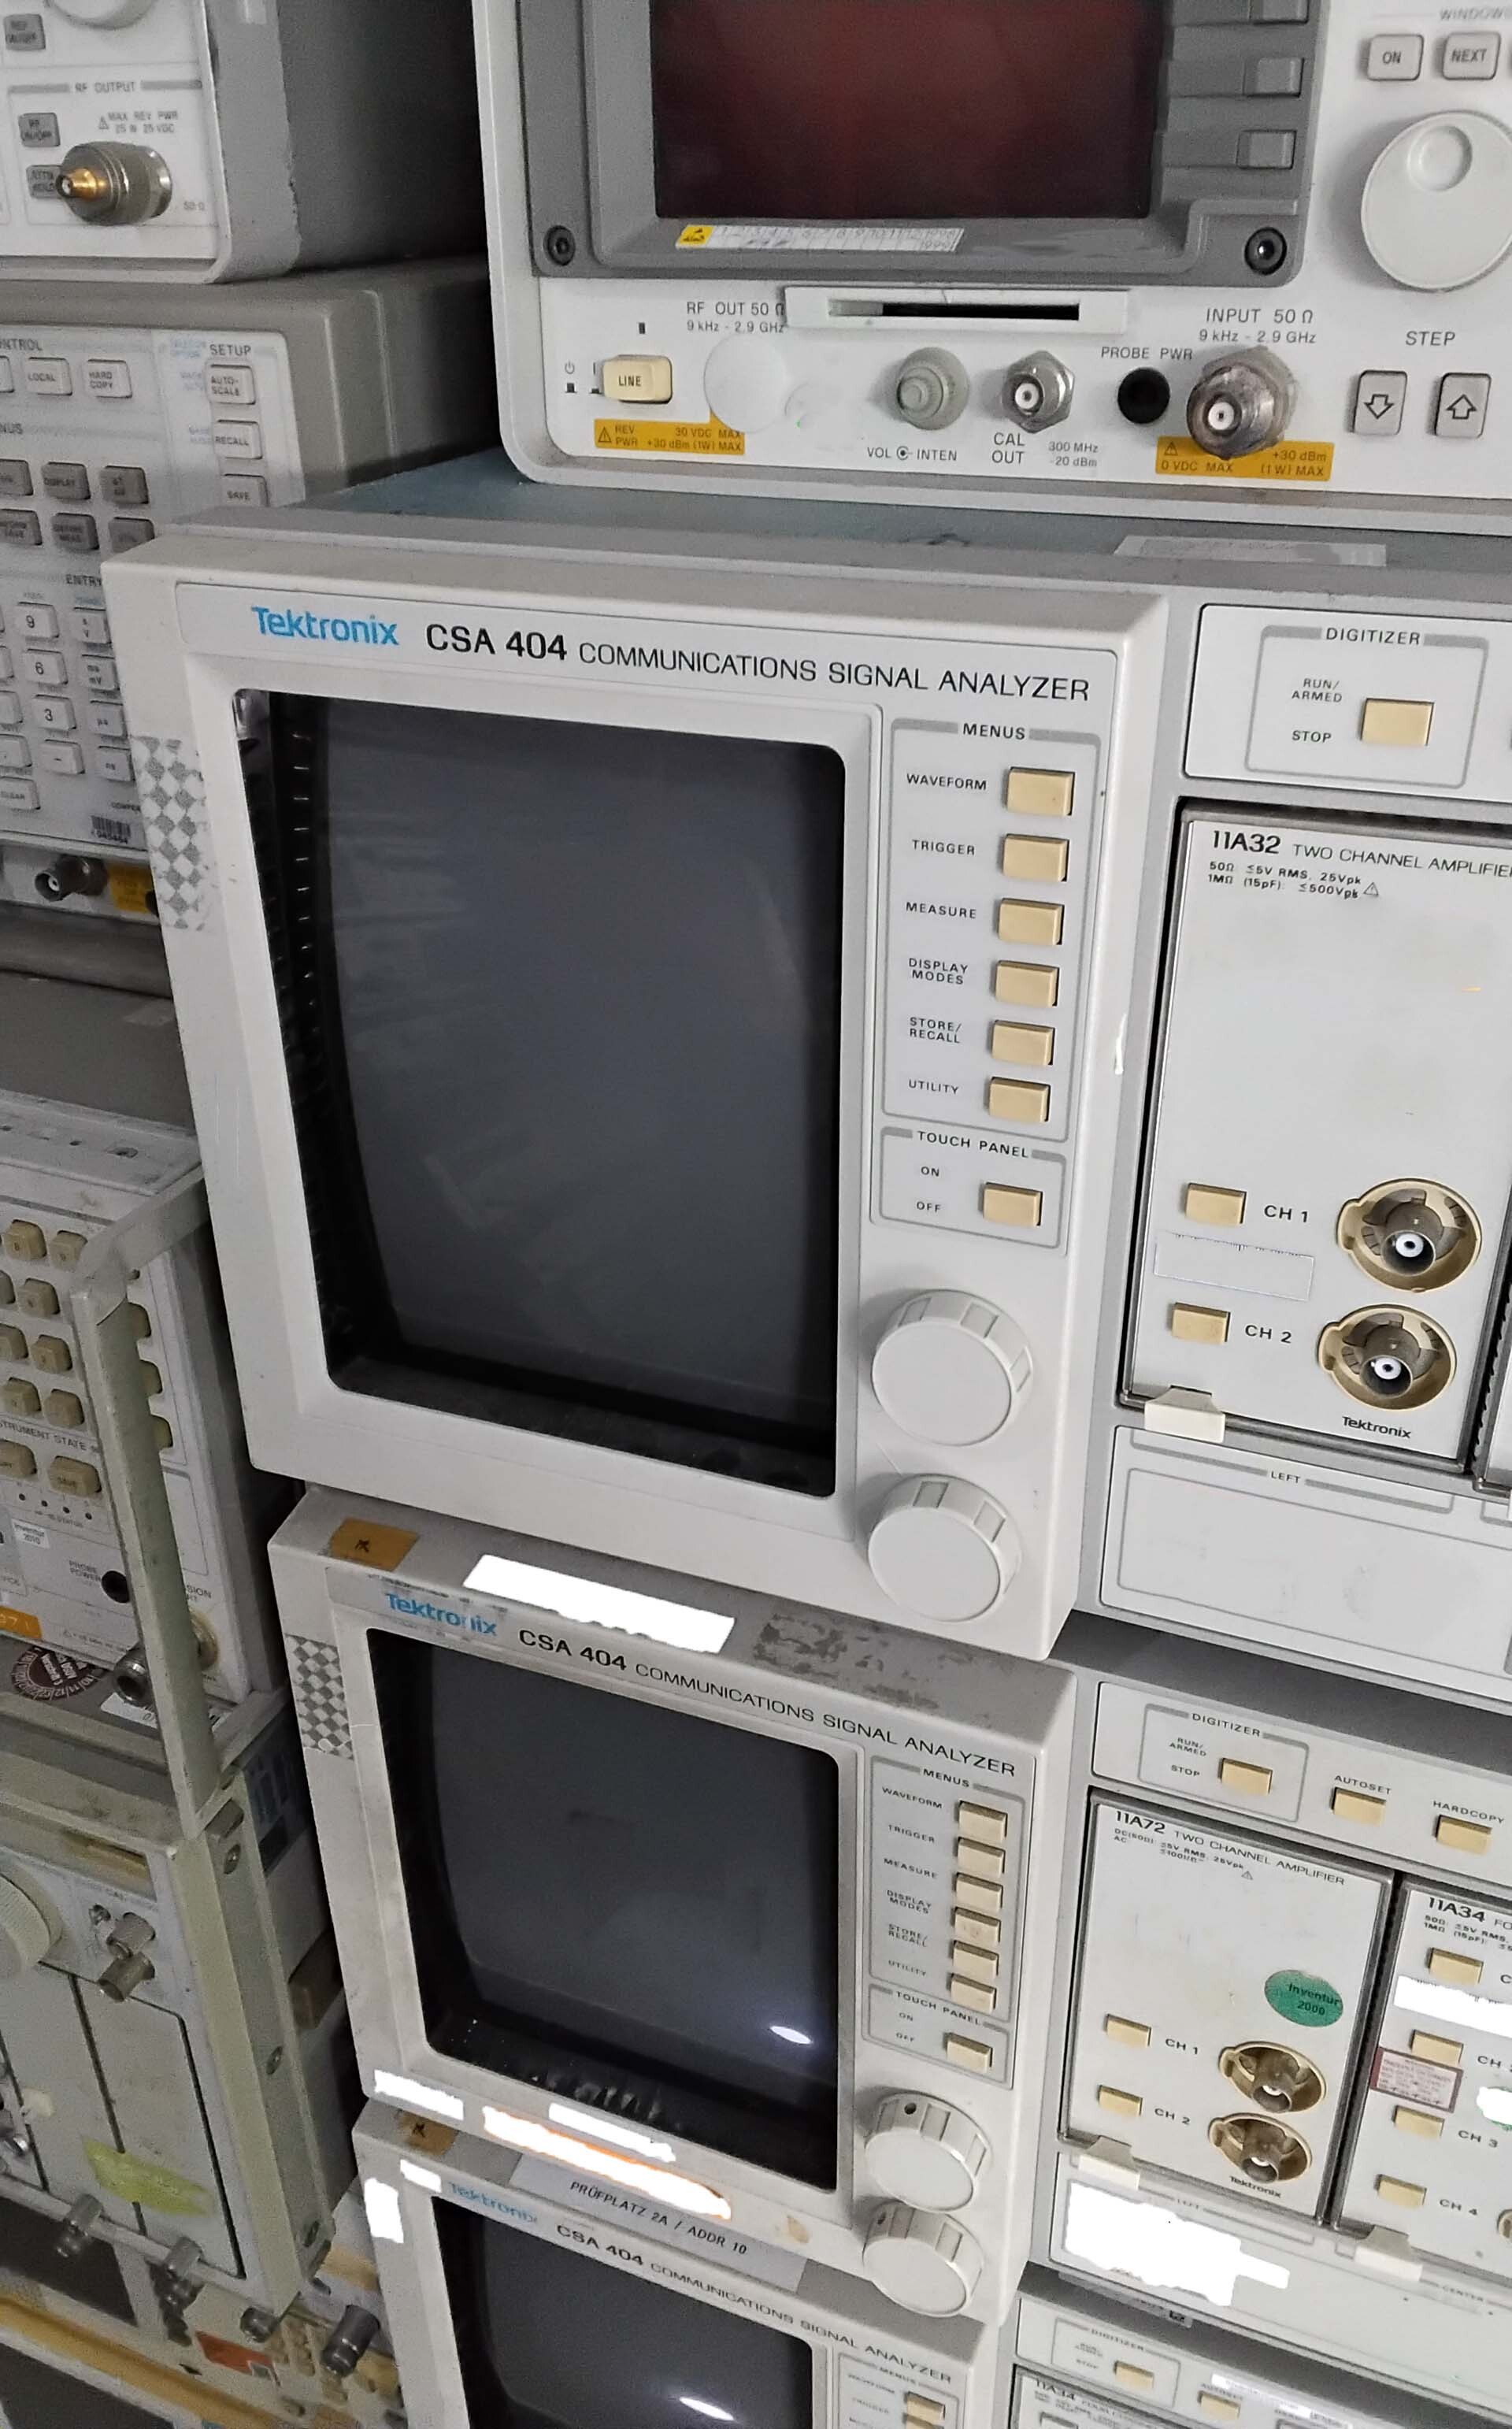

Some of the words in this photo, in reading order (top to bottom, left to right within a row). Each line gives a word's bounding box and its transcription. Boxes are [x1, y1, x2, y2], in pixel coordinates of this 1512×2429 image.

[1440, 6, 1505, 20] WINDOW
[1381, 52, 1402, 65] ON
[1451, 49, 1488, 62] NEXT
[75, 81, 87, 92] RF
[94, 82, 136, 93] OUTPUT
[687, 302, 705, 314] RF
[715, 302, 745, 315] OUT
[751, 302, 769, 315] 50
[1206, 308, 1262, 324] INPUT
[1273, 309, 1297, 324] 50
[687, 321, 694, 332] 9
[698, 321, 720, 332] kHz
[759, 321, 784, 333] GHz
[1199, 331, 1208, 342] 9
[1212, 331, 1239, 342] kHz
[1285, 332, 1317, 343] GHz
[1405, 332, 1456, 347] STEP
[209, 344, 251, 356] SETUP
[1101, 347, 1151, 358] PROBE
[1159, 348, 1193, 360] PWR
[28, 373, 56, 383] LOCAL
[89, 371, 113, 380] HARD
[618, 376, 642, 387] LINE
[90, 380, 113, 390] COPY
[615, 425, 635, 435] REV
[675, 428, 687, 438] 30
[691, 428, 712, 439] VDC
[718, 430, 742, 439] MAX
[215, 436, 250, 446] RECALL
[615, 438, 638, 447] PWR
[647, 439, 667, 450] +30
[669, 440, 691, 451] dBm
[718, 441, 742, 452] MAX
[994, 432, 1026, 447] CAL
[867, 446, 891, 458] VOL
[1048, 441, 1070, 451] 300
[1073, 443, 1099, 454] MHz
[917, 450, 958, 462] INTEN
[991, 450, 1025, 464] OUT
[1073, 456, 1098, 467] dBm
[1273, 451, 1297, 462] +30
[1299, 451, 1327, 462] dBm
[1161, 461, 1169, 471] 0
[1173, 461, 1198, 472] VDC
[1206, 462, 1234, 473] MAX
[1295, 465, 1324, 477] MAX
[66, 573, 102, 587] ENTRY
[26, 615, 35, 629] 9
[1326, 628, 1421, 645] DIGITIZER
[251, 606, 400, 646] Tektronix
[426, 623, 495, 655] CSA
[506, 632, 568, 660] 404
[579, 642, 817, 682] COMMUNICATIONS
[828, 662, 928, 692] SIGNAL
[939, 670, 1090, 703] ANALYZER
[35, 662, 44, 675] 6
[1303, 678, 1340, 690] RUN/
[1292, 691, 1343, 703] ARMED
[44, 709, 53, 721] 3
[963, 723, 1025, 740] MENUS
[1292, 730, 1332, 743] STOP
[906, 773, 987, 791] WAVEFORM
[912, 839, 975, 855] TRIGGER
[1212, 829, 1281, 855] 11A32
[1293, 843, 1332, 860] TWO
[1340, 848, 1421, 869] CHANNEL
[1321, 871, 1361, 884] 25Vpk
[906, 901, 976, 919] MEASURE
[909, 957, 969, 974] DISPLAY
[912, 970, 964, 985] MODES
[910, 1017, 962, 1033] STORE/
[910, 1029, 961, 1044] RECALL
[909, 1080, 960, 1095] UTILITY
[917, 1130, 971, 1148] TOUCH
[979, 1140, 1029, 1158] PANEL
[921, 1166, 939, 1177] ON
[916, 1201, 942, 1213] OFF
[1264, 1204, 1292, 1222] CH
[1300, 1211, 1309, 1224] 1
[1245, 1325, 1273, 1341] CH
[1280, 1330, 1292, 1344] 2
[1342, 1416, 1412, 1440] Tektronix
[1270, 1470, 1302, 1485] LEFT
[519, 1629, 572, 1656] CSA
[579, 1647, 627, 1671] 404
[636, 1663, 814, 1723] COMMUNICATIONS
[823, 1713, 898, 1746] SIGNAL
[905, 1737, 1016, 1778] ANALYZER
[1191, 1712, 1261, 1738] DIGITIZER
[1169, 1742, 1207, 1757] ARMED
[1177, 1737, 1204, 1750] RUN/
[923, 1768, 970, 1788] MENUS
[1171, 1764, 1200, 1778] STOP
[1335, 1774, 1392, 1796] AUTOSET
[882, 1786, 943, 1809] WAVEFORM
[1432, 1800, 1506, 1825] HARDCOPY
[888, 1824, 935, 1843] TRIGGER
[1114, 1835, 1127, 1844] AC
[1115, 1811, 1166, 1834] 11A72
[1175, 1830, 1204, 1845] TWO
[1210, 1840, 1271, 1866] CHANNEL
[1277, 1858, 1346, 1886] AMPLIFIER
[884, 1857, 938, 1879] MEASURE
[887, 1889, 932, 1909] DISPLAY
[890, 1897, 929, 1915] MODES
[1429, 1897, 1485, 1923] 11A34
[888, 1930, 927, 1948] RECALL
[888, 1960, 927, 1977] UTILITY
[1288, 1982, 1342, 2008] Inventur
[896, 1990, 937, 2010] TOUCH
[943, 2007, 980, 2026] PANEL
[1297, 2000, 1326, 2016] 2000
[899, 2012, 914, 2022] ON
[1165, 2038, 1187, 2051] CH
[1192, 2045, 1199, 2055] 1
[1477, 2055, 1501, 2068] CH
[1154, 2107, 1177, 2122] CH
[1180, 2116, 1191, 2126] 2
[1458, 2129, 1481, 2143] CH
[1488, 2139, 1499, 2149] 3
[1230, 2175, 1282, 2199] Tektronix
[1440, 2199, 1462, 2211] CH
[570, 2180, 647, 2217] PRÜFPLATZ
[652, 2211, 669, 2227] 2A
[687, 2225, 726, 2249] ADDR
[733, 2242, 748, 2256] 10
[556, 2223, 600, 2251] CSA
[606, 2244, 643, 2267] 404
[650, 2262, 794, 2325] COMMUNICATIONS
[799, 2319, 857, 2348] SIGNAL
[865, 2345, 952, 2384] ANALYZER
